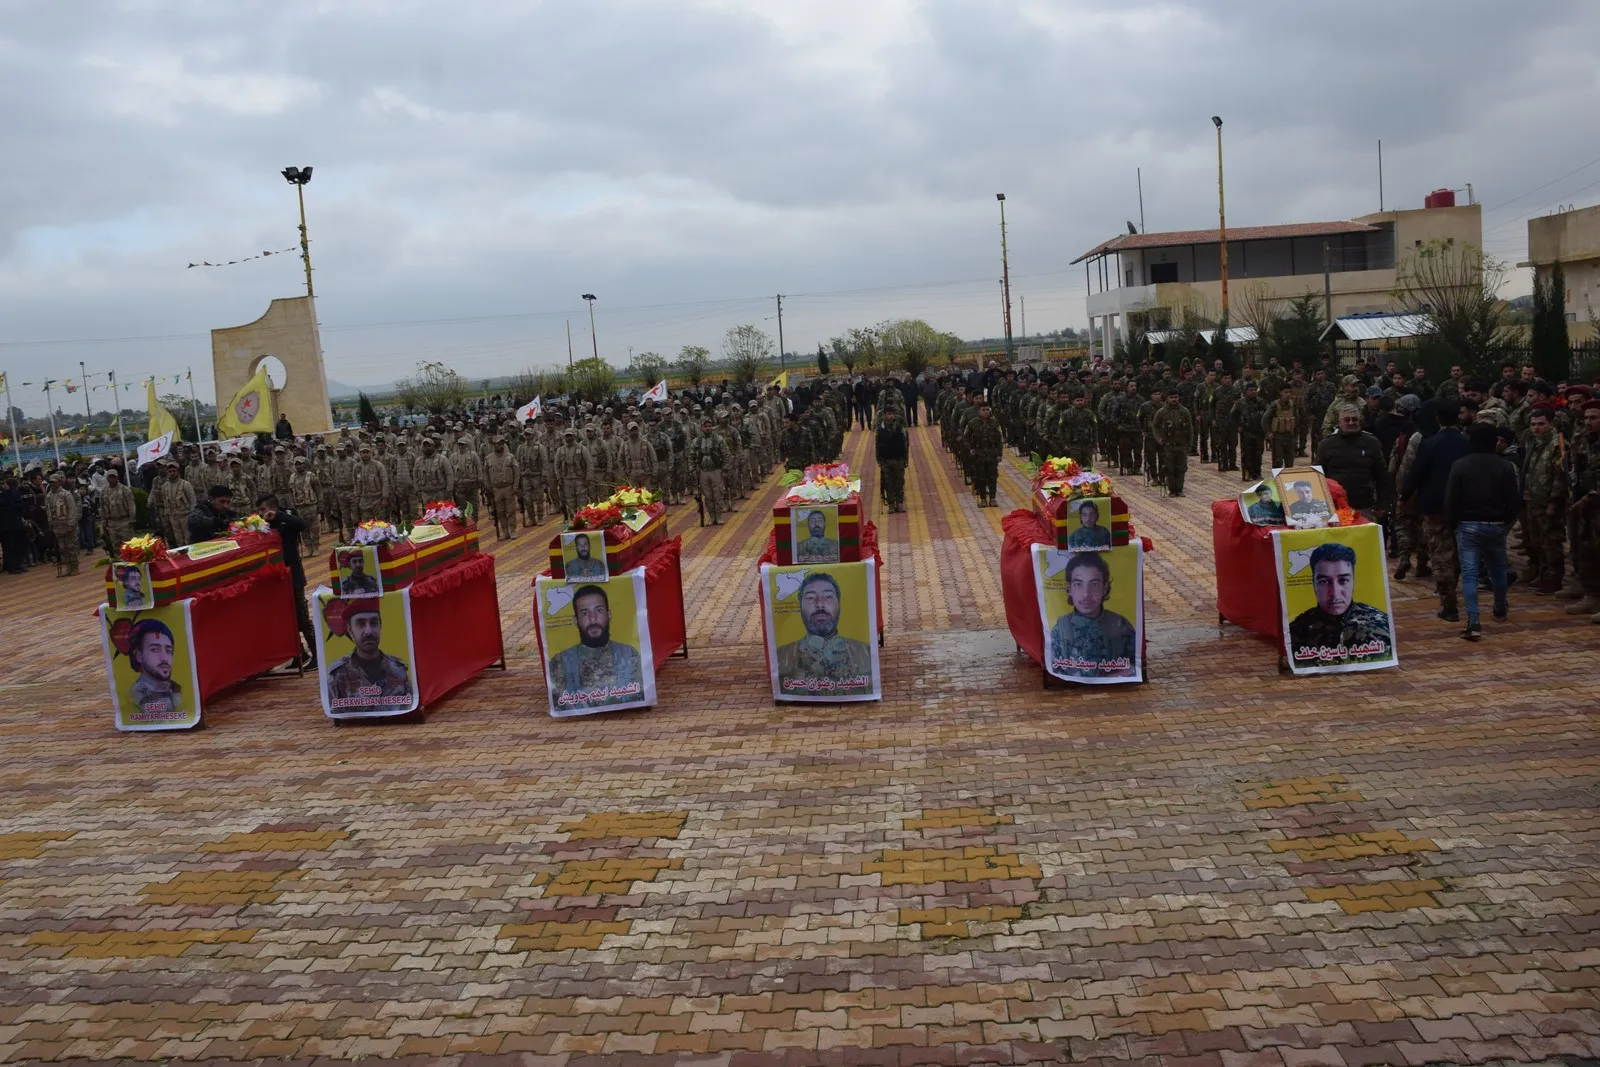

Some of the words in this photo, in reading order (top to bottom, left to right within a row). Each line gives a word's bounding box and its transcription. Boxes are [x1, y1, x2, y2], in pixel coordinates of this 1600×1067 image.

[1294, 646, 1318, 660] خلف
[1319, 644, 1348, 660] ياسين
[1349, 640, 1385, 658] الشهيد
[1076, 656, 1097, 671] سيف
[1098, 657, 1131, 672] الشهيد
[609, 681, 641, 698] الشهيد
[782, 676, 807, 690] حسين
[807, 676, 836, 691] رضوان
[836, 675, 868, 690] الشهيد
